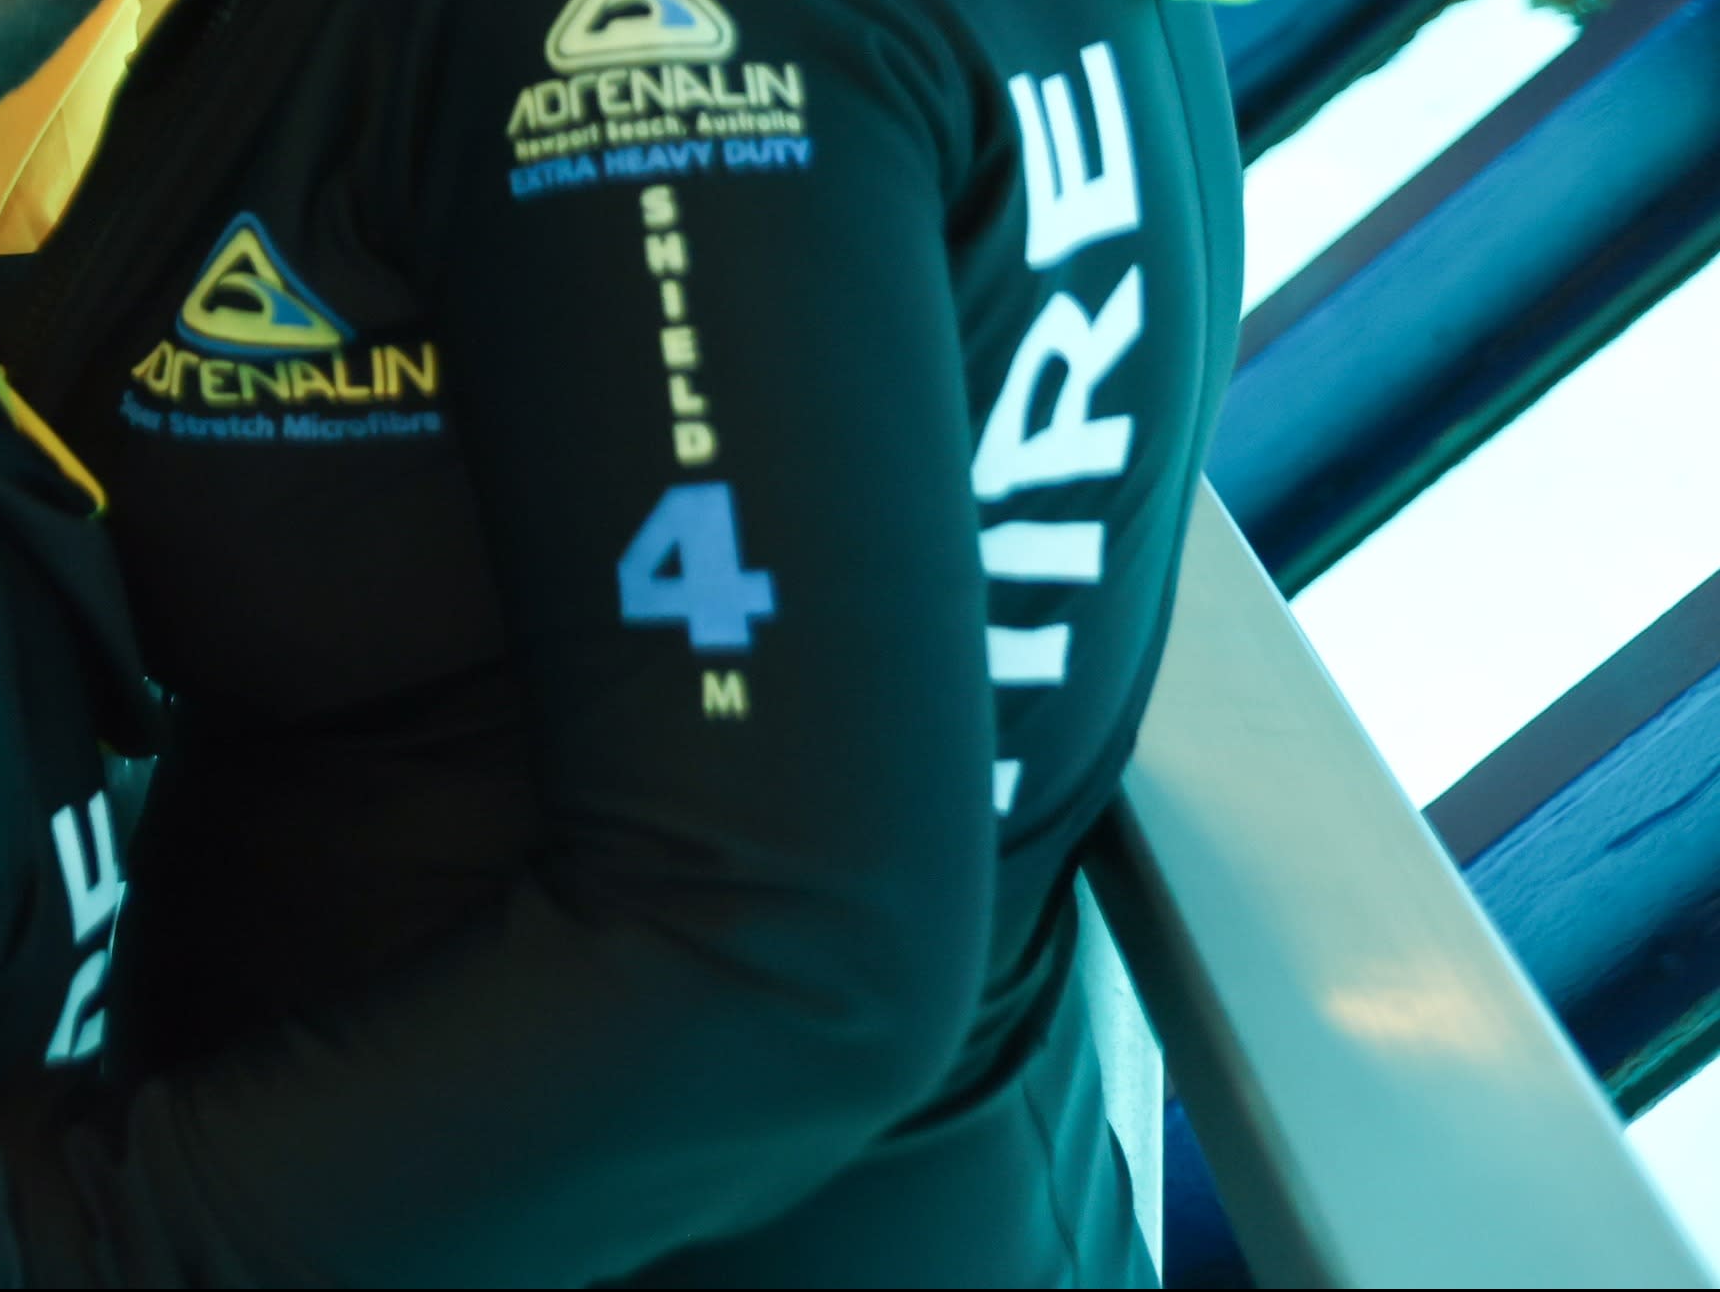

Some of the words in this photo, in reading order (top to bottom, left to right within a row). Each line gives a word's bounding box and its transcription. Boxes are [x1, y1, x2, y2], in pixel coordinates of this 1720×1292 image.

[507, 63, 804, 136] ADRENALIN
[509, 153, 599, 197] EXTRA
[604, 140, 714, 177] HEAVY
[724, 136, 812, 167] DUTY
[640, 184, 717, 466] SHIELD
[130, 339, 438, 408] ADRENALIN
[168, 411, 275, 439] Stretch
[617, 480, 775, 653] 4
[702, 670, 747, 717] M
